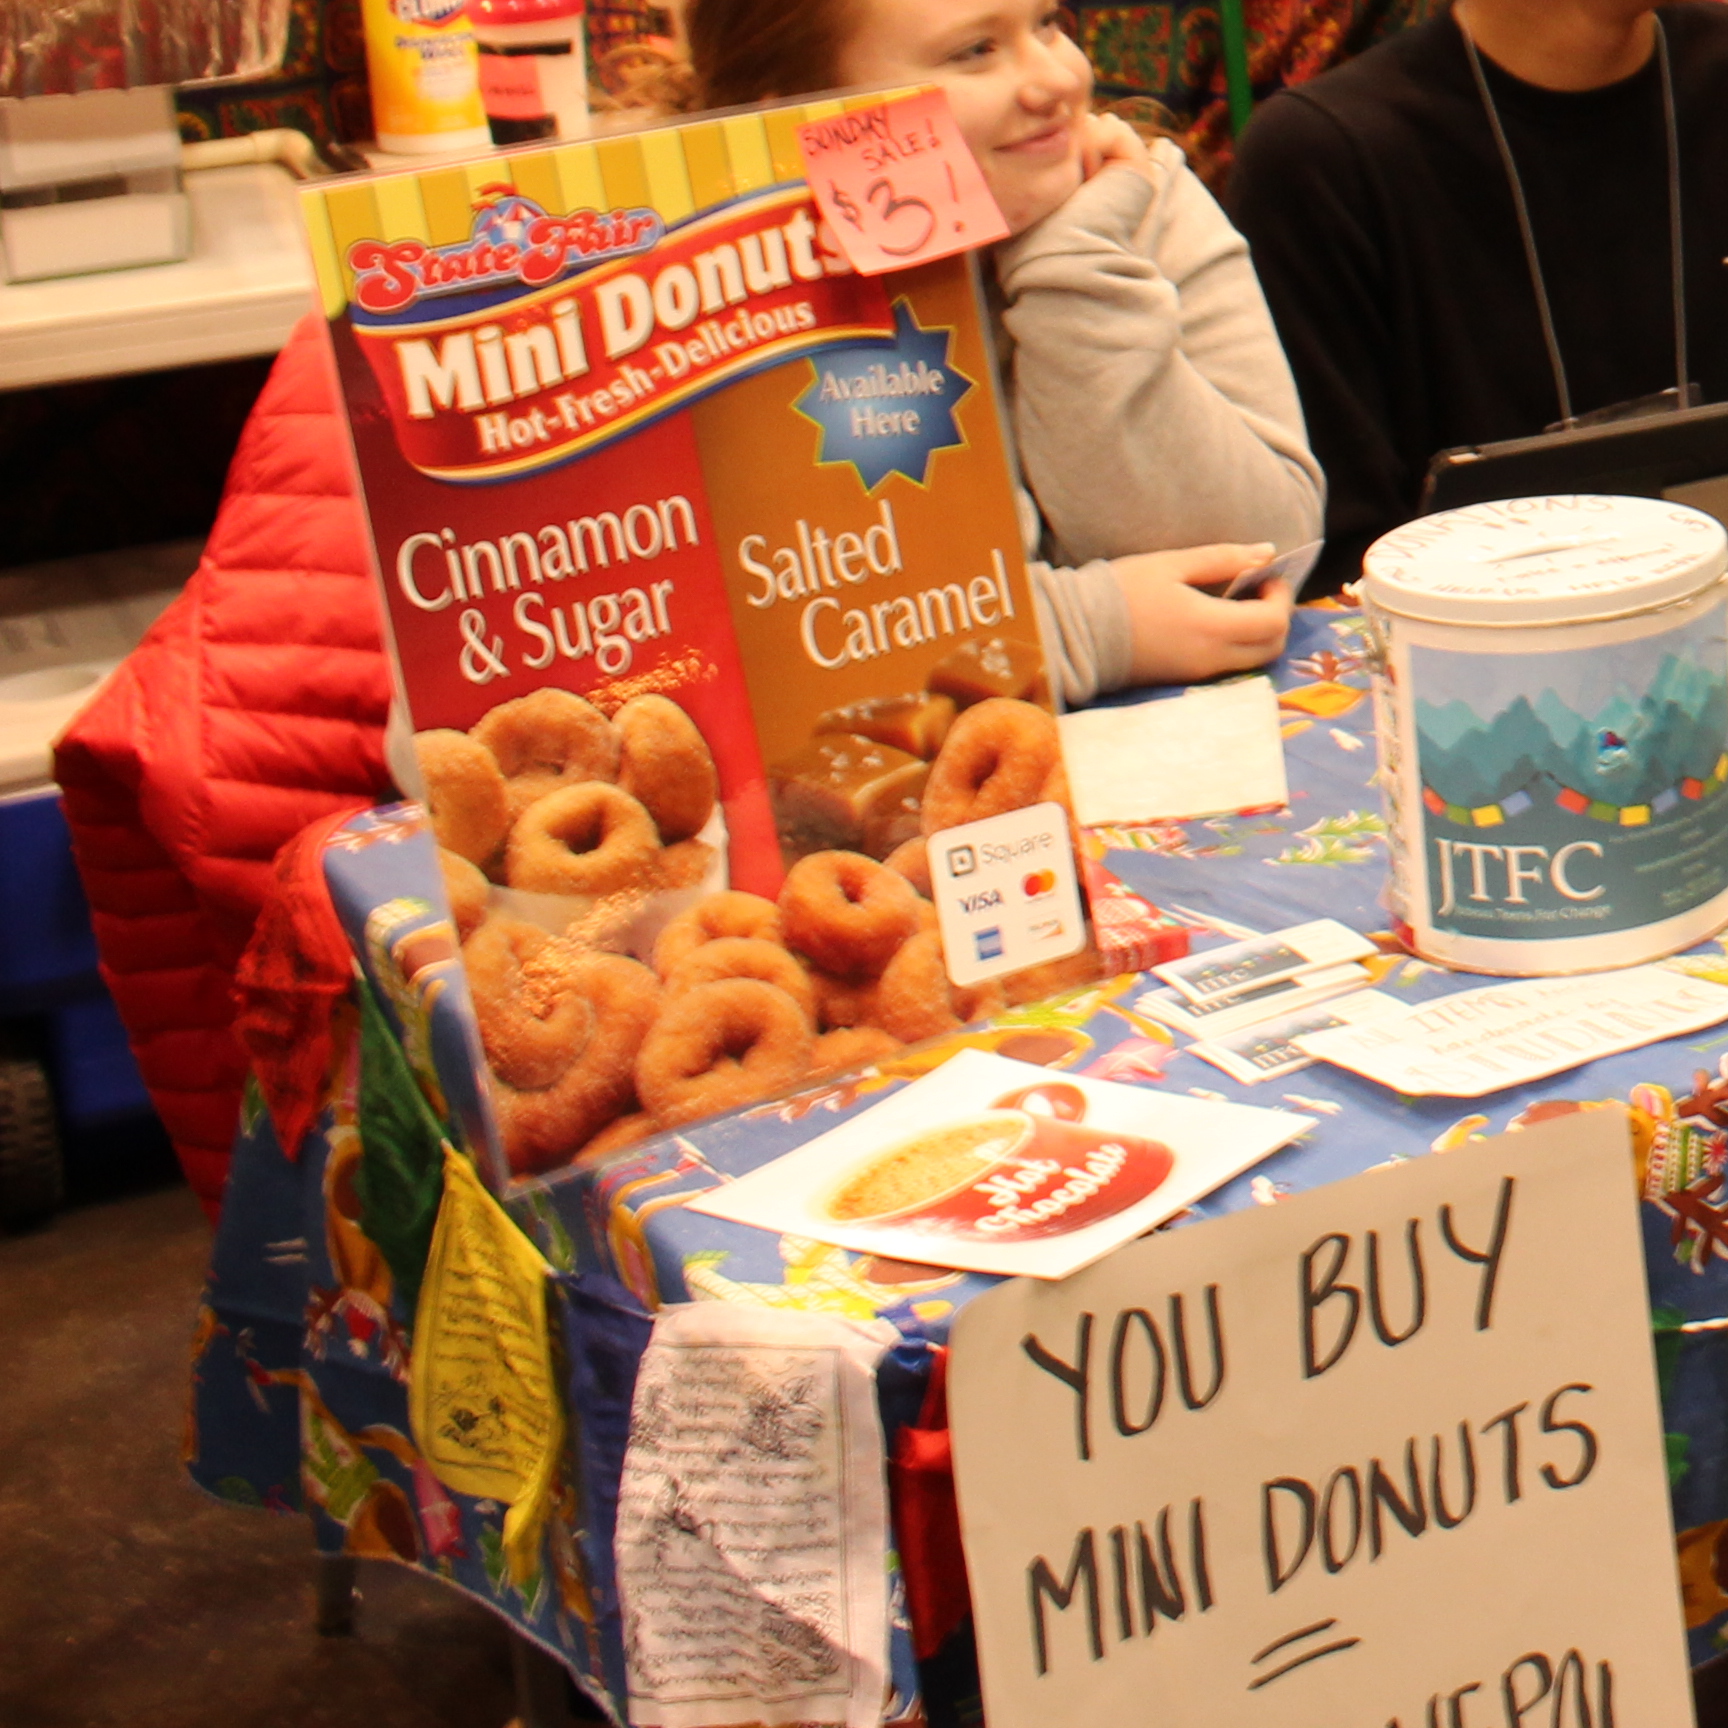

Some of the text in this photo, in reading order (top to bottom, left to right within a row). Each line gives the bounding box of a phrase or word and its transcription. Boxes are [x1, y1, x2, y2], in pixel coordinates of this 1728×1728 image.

[803, 104, 893, 156] SUNDAY
[347, 208, 658, 313] State Fair
[396, 298, 591, 420] Mini
[478, 300, 816, 455] Hot-Fresh-Delicious
[819, 359, 946, 403] Available
[850, 405, 922, 439] Here
[397, 493, 700, 613] Cinnamon
[737, 500, 903, 609] Salted
[1368, 495, 1615, 561] DONATIONS
[458, 576, 677, 685] & Sugar
[800, 548, 1017, 671] Caramel
[979, 830, 1053, 868] Square
[1434, 836, 1608, 918] JTFC
[958, 888, 1004, 914] VISA
[1405, 992, 1530, 1036] ITEMS
[971, 1154, 1062, 1208] Hot
[974, 1142, 1129, 1238] Chocolate
[1020, 1175, 1517, 1464] YOU BUY
[1023, 1381, 1602, 1679] MINI DONUTS
